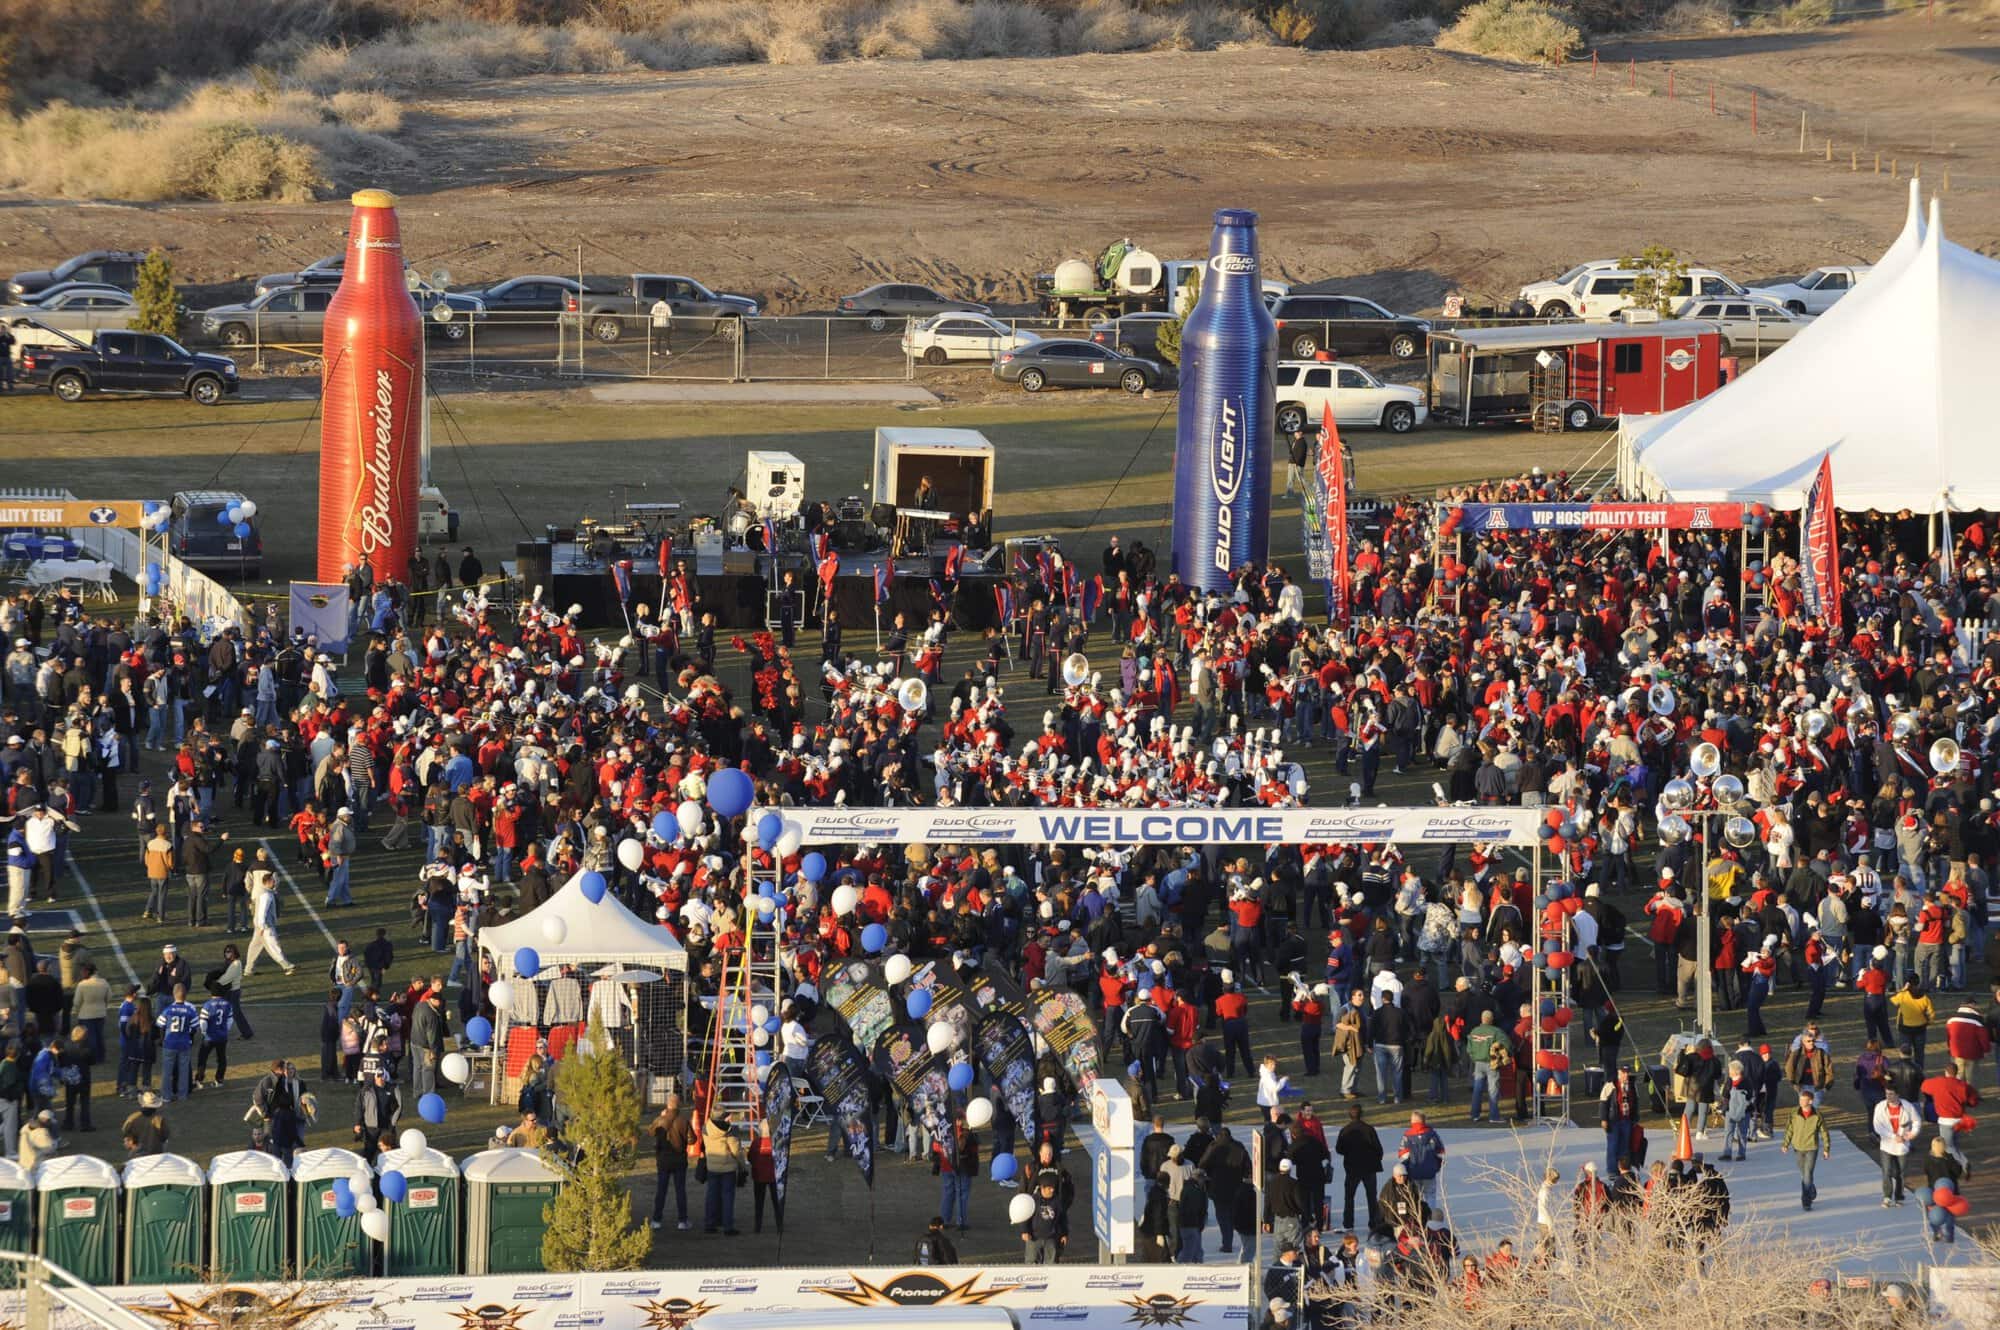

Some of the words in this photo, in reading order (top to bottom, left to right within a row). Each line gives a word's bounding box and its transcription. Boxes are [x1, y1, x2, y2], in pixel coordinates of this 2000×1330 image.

[1225, 256, 1254, 264] BUD
[1219, 398, 1236, 491] LIGHT
[361, 369, 393, 554] Budweiser
[32, 508, 64, 523] TENT
[1532, 511, 1554, 525] VIP
[1556, 510, 1635, 525] HOSPITALITY
[1638, 510, 1667, 525] TENT
[1215, 505, 1232, 573] BUD
[815, 816, 848, 824] BUD
[855, 816, 900, 825] LIGHT
[932, 818, 965, 826] BUD
[973, 818, 1016, 826] LIGHT
[1310, 818, 1344, 826] BUD
[1351, 818, 1395, 826] LIGHT
[1427, 818, 1461, 826] BUD
[1468, 818, 1512, 827] LIGHT
[1039, 816, 1284, 841] WELCOME
[1859, 872, 1873, 889] 10
[170, 1015, 186, 1033] 21
[215, 1008, 224, 1025] 3
[890, 1287, 945, 1297] Pioneer
